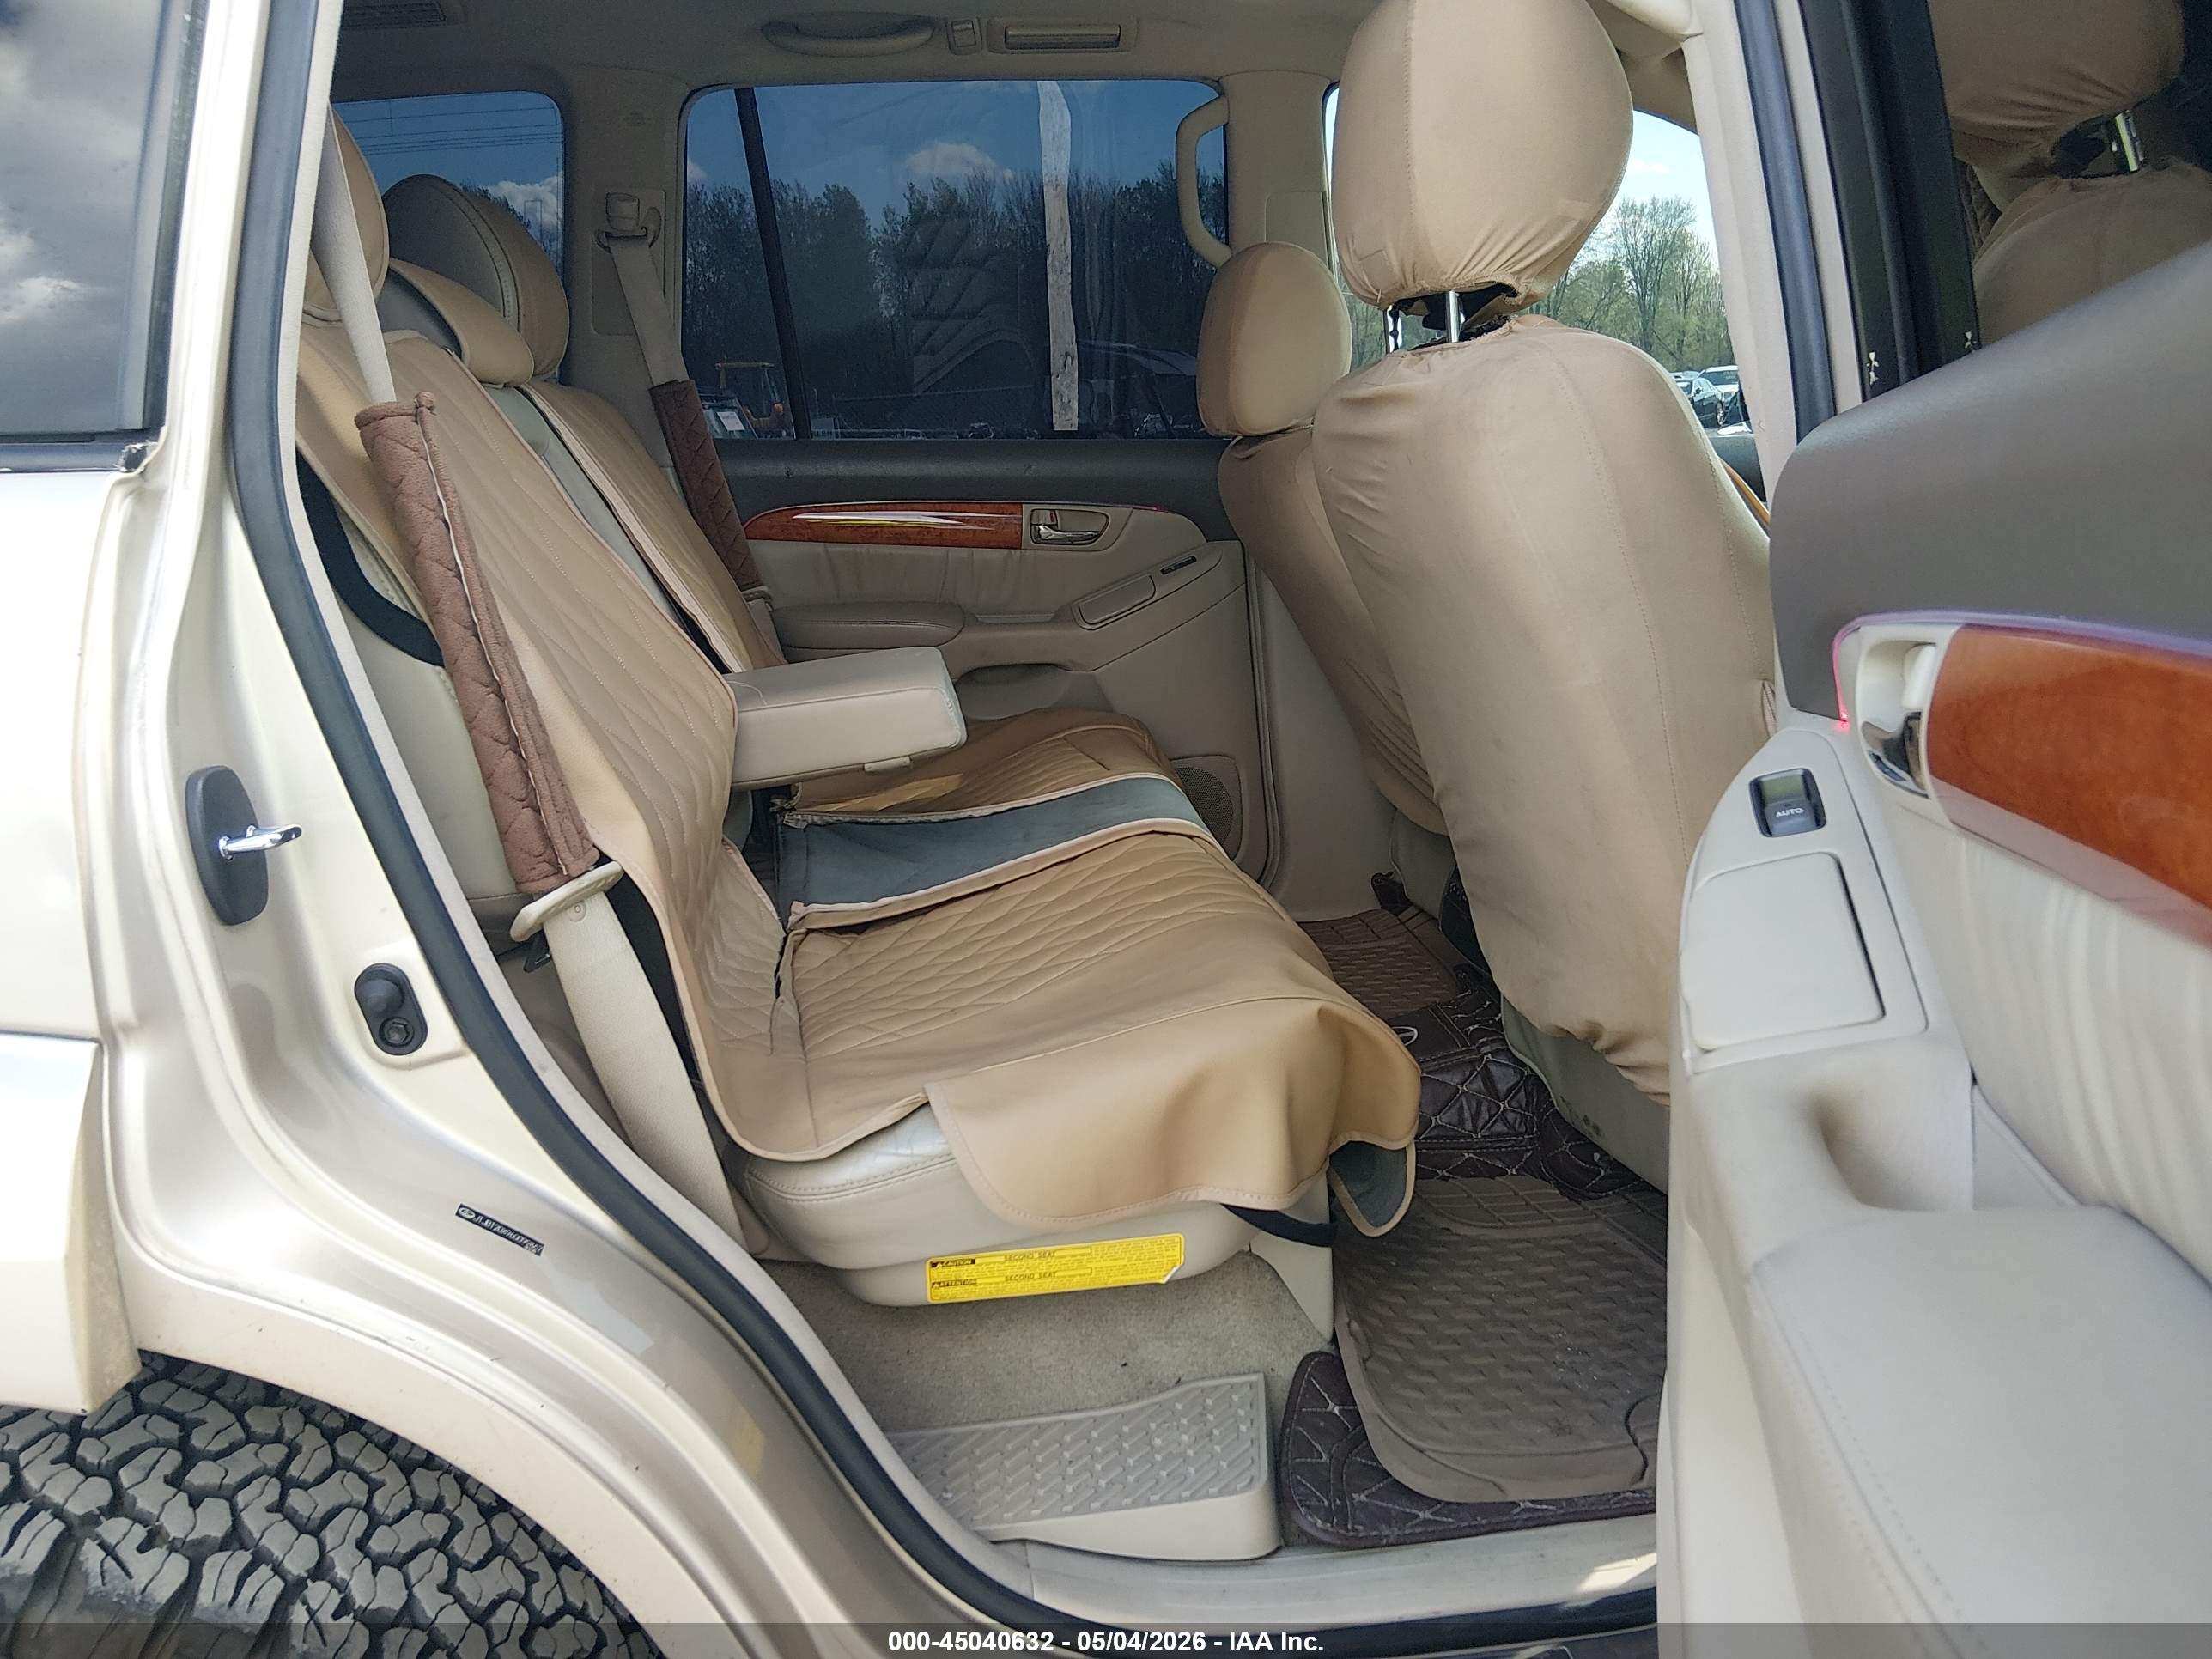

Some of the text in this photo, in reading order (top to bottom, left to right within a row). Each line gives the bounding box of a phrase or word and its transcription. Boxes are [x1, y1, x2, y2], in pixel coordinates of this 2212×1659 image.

[1775, 807, 1804, 818] AUTO
[1004, 1250, 1057, 1261] SECOND SEAT
[941, 1258, 972, 1267] CAUTION
[1005, 1273, 1035, 1282] SECOND
[1039, 1271, 1058, 1279] SEAT
[939, 1278, 977, 1288] ATTENTION
